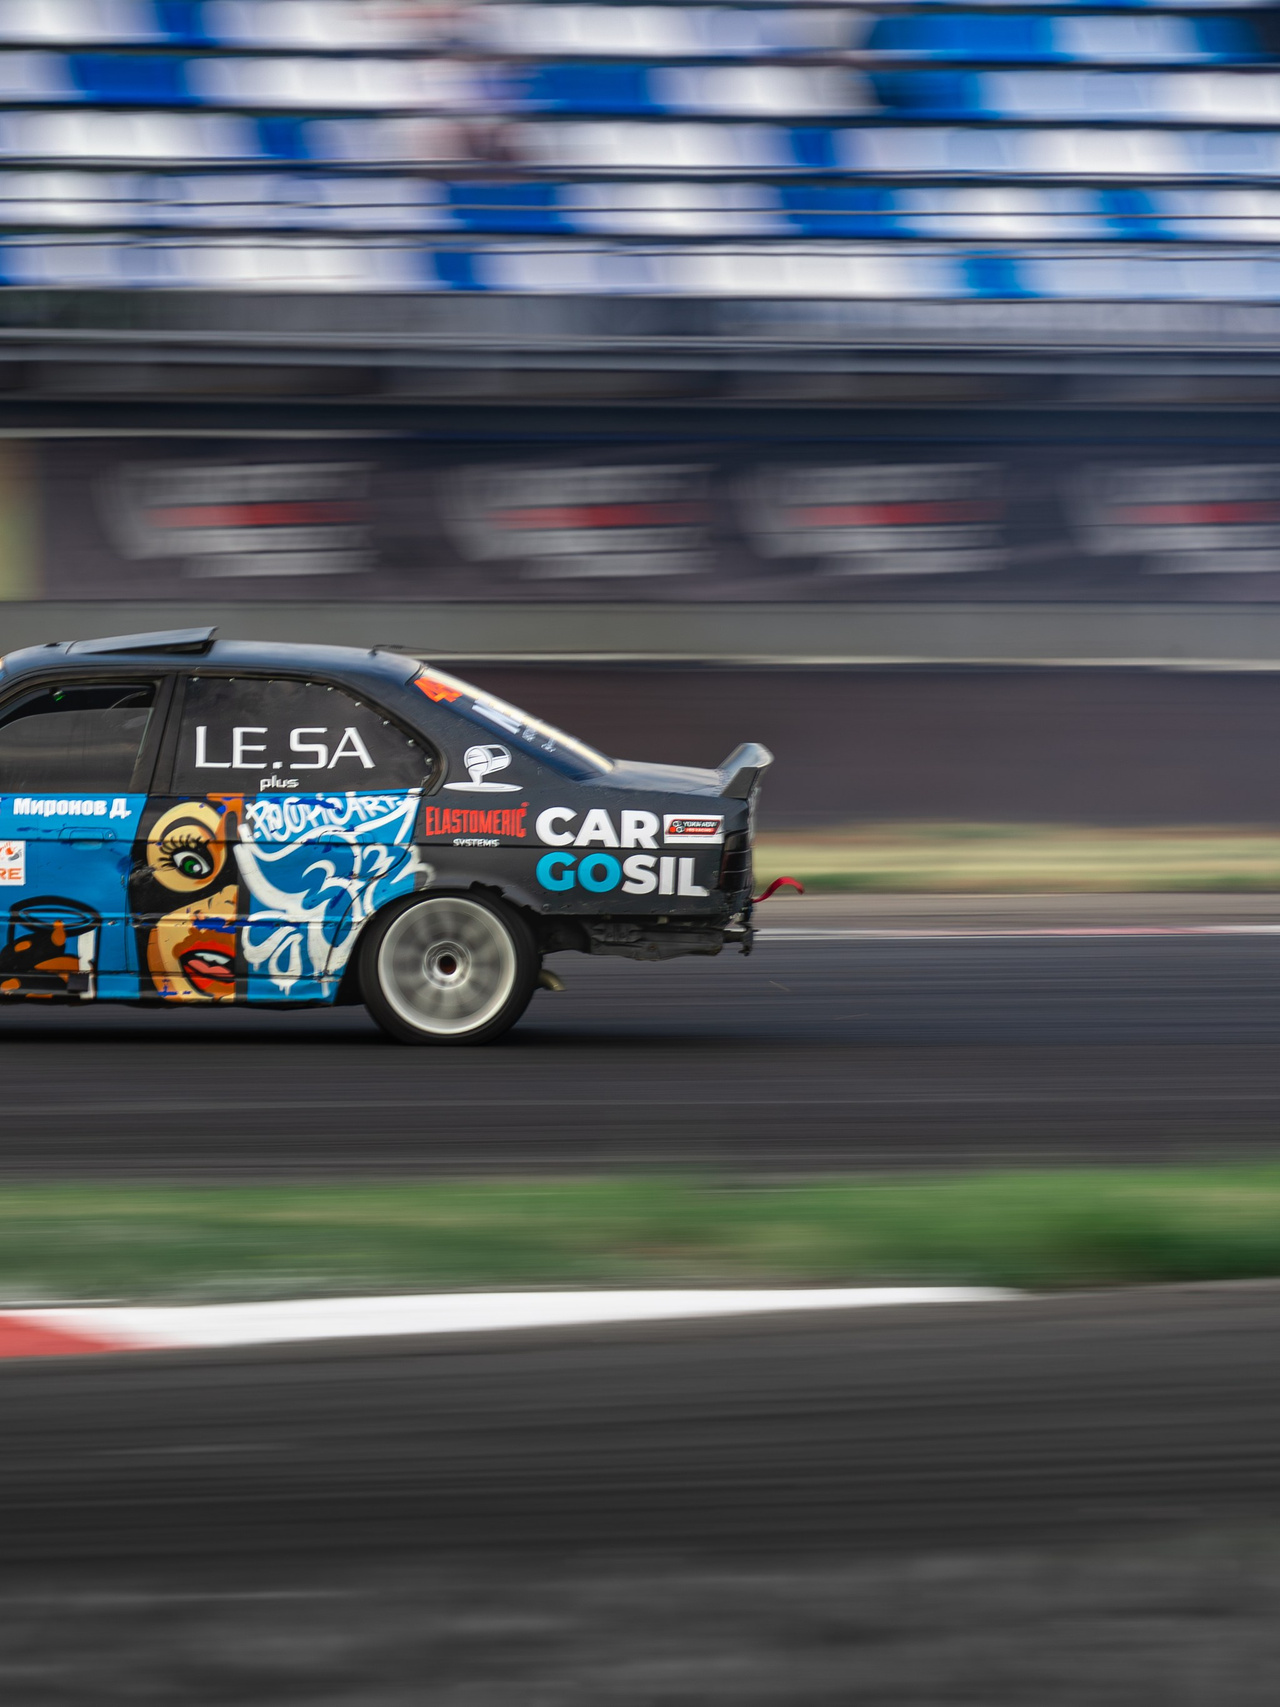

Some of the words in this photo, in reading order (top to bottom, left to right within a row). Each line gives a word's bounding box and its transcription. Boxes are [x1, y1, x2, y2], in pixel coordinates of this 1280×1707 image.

[195, 725, 376, 769] LE.SA
[260, 775, 299, 791] plus
[13, 797, 107, 818] Миронов
[425, 805, 528, 838] ELASTOMERIC
[453, 838, 500, 847] SYSTEMS
[535, 806, 660, 849] CAR
[535, 851, 711, 897] GOSIL
